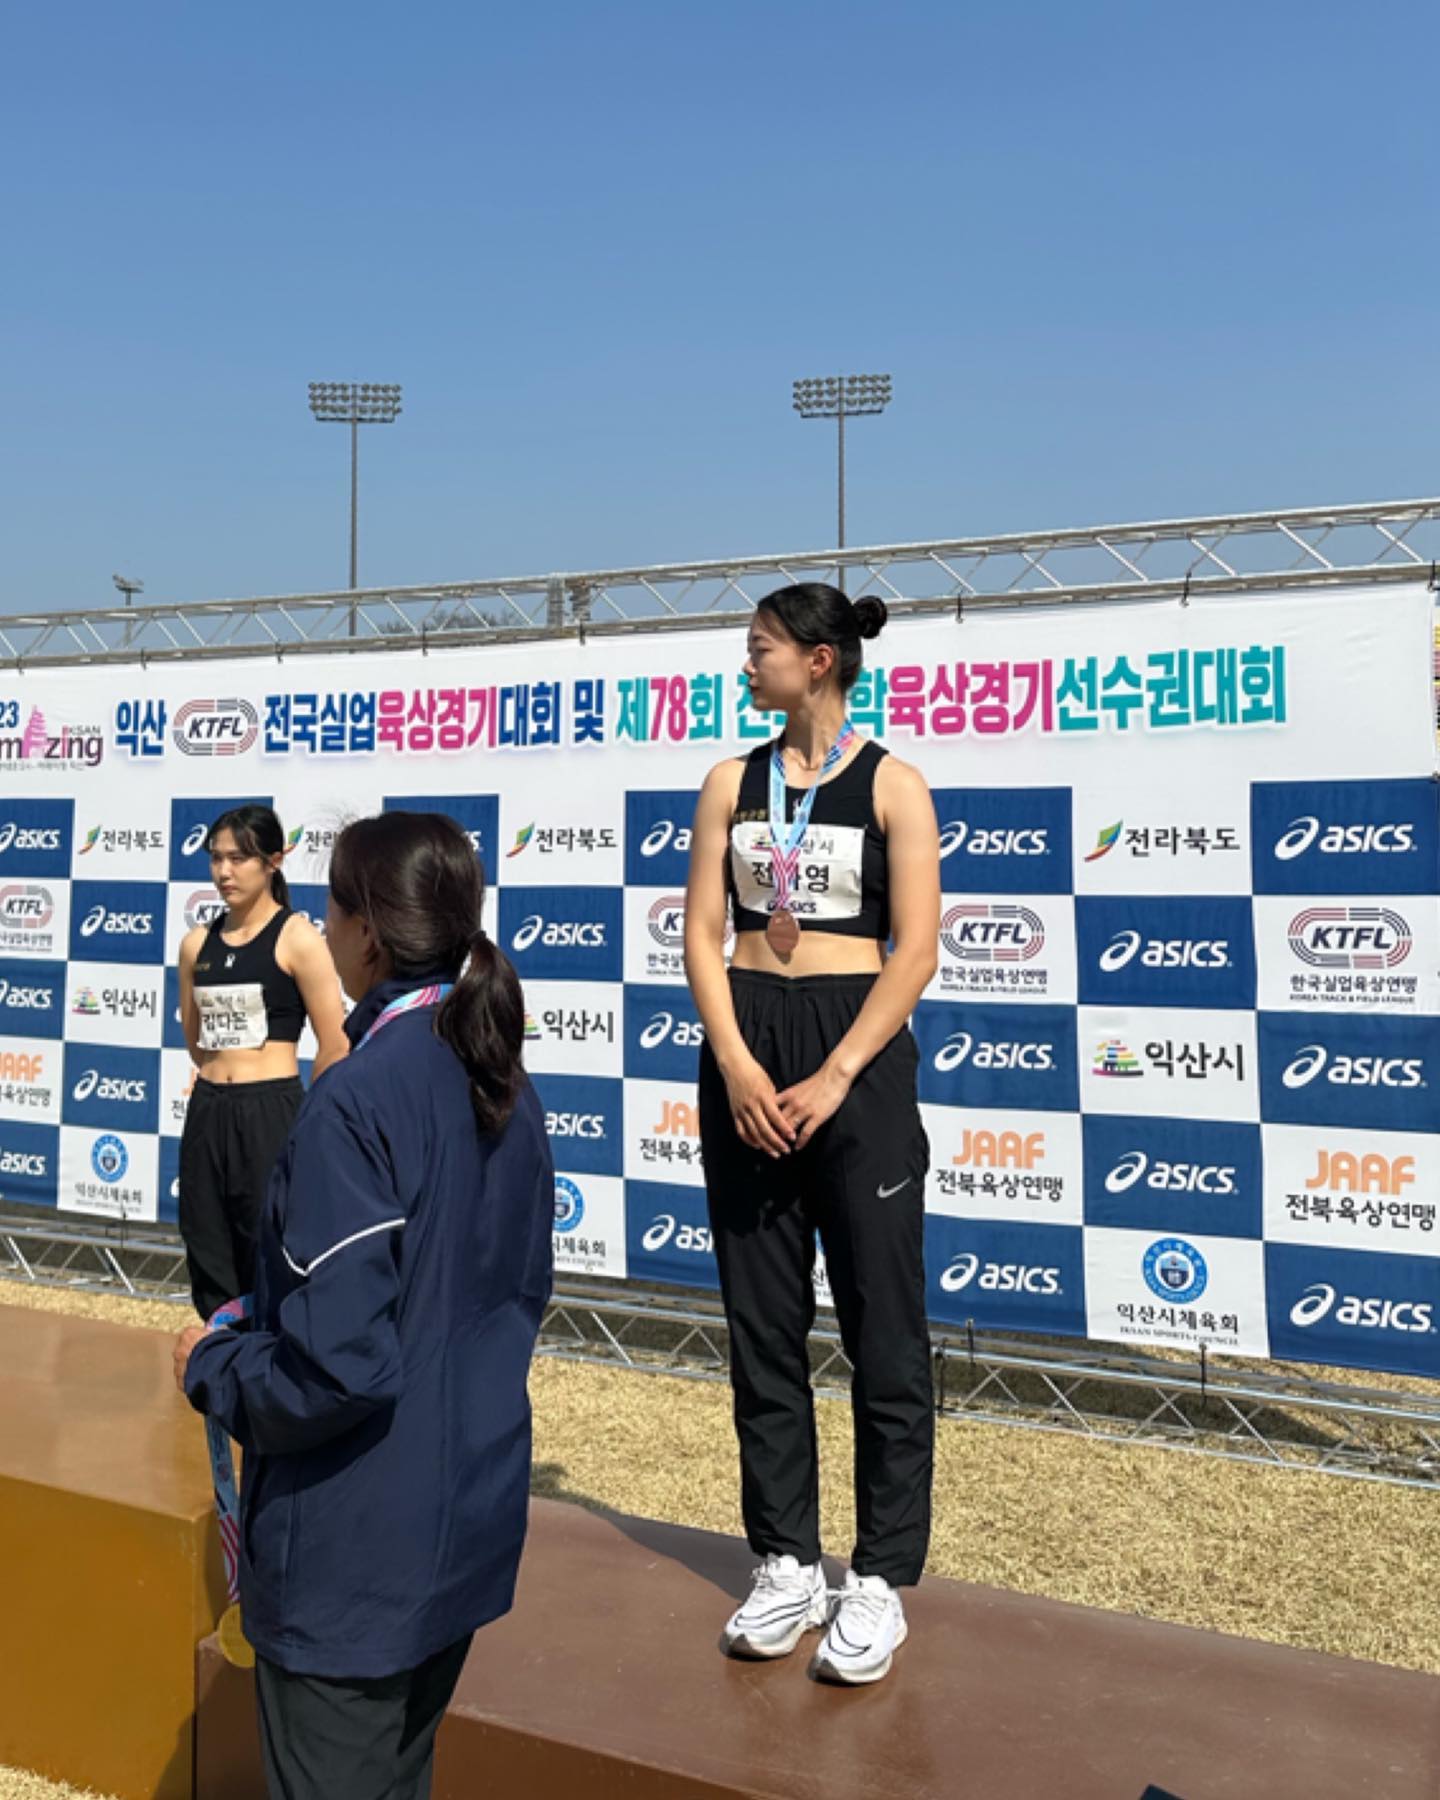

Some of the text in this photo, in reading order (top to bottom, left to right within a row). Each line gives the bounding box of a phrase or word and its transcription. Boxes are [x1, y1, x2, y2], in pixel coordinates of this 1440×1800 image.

[115, 699, 167, 756] 익산
[189, 716, 244, 739] KTFL
[264, 681, 562, 753] 전국실업육상경기대회
[573, 679, 605, 743] 및
[615, 673, 723, 741] 제78회
[737, 646, 1287, 738] 전학육상경기선수권대회
[15, 828, 60, 849] asics
[102, 829, 164, 852] 전라북도
[536, 828, 617, 853] 전라북도
[967, 829, 1048, 855] asics
[1125, 827, 1241, 857] 전라북도
[1319, 823, 1414, 853] asics
[5, 899, 44, 916] KTFL
[103, 911, 153, 935] asics
[542, 922, 605, 947] asics
[958, 922, 1028, 944] KTFL
[1310, 927, 1394, 950] KTFL
[1140, 939, 1229, 968] asics
[6, 985, 52, 1009] asics
[102, 989, 157, 1018] 익산시
[543, 1009, 614, 1043] 익산시
[0, 1052, 43, 1082] AAF
[972, 1041, 1053, 1069] asics
[1145, 1040, 1244, 1081] 익산시
[1327, 1056, 1424, 1088] asics
[97, 1079, 146, 1101] asics
[545, 1111, 605, 1138] asics
[952, 1129, 1045, 1169] JAAF
[1, 1152, 46, 1176] asics
[1147, 1160, 1236, 1193] asics
[1305, 1149, 1416, 1195] JAAF
[936, 1169, 1063, 1202] 전북육상연맹
[1285, 1194, 1437, 1231] 전북육상연맹
[978, 1262, 1060, 1294] asics
[1116, 1303, 1239, 1334] 익산시체육회
[1336, 1295, 1433, 1333] asics
